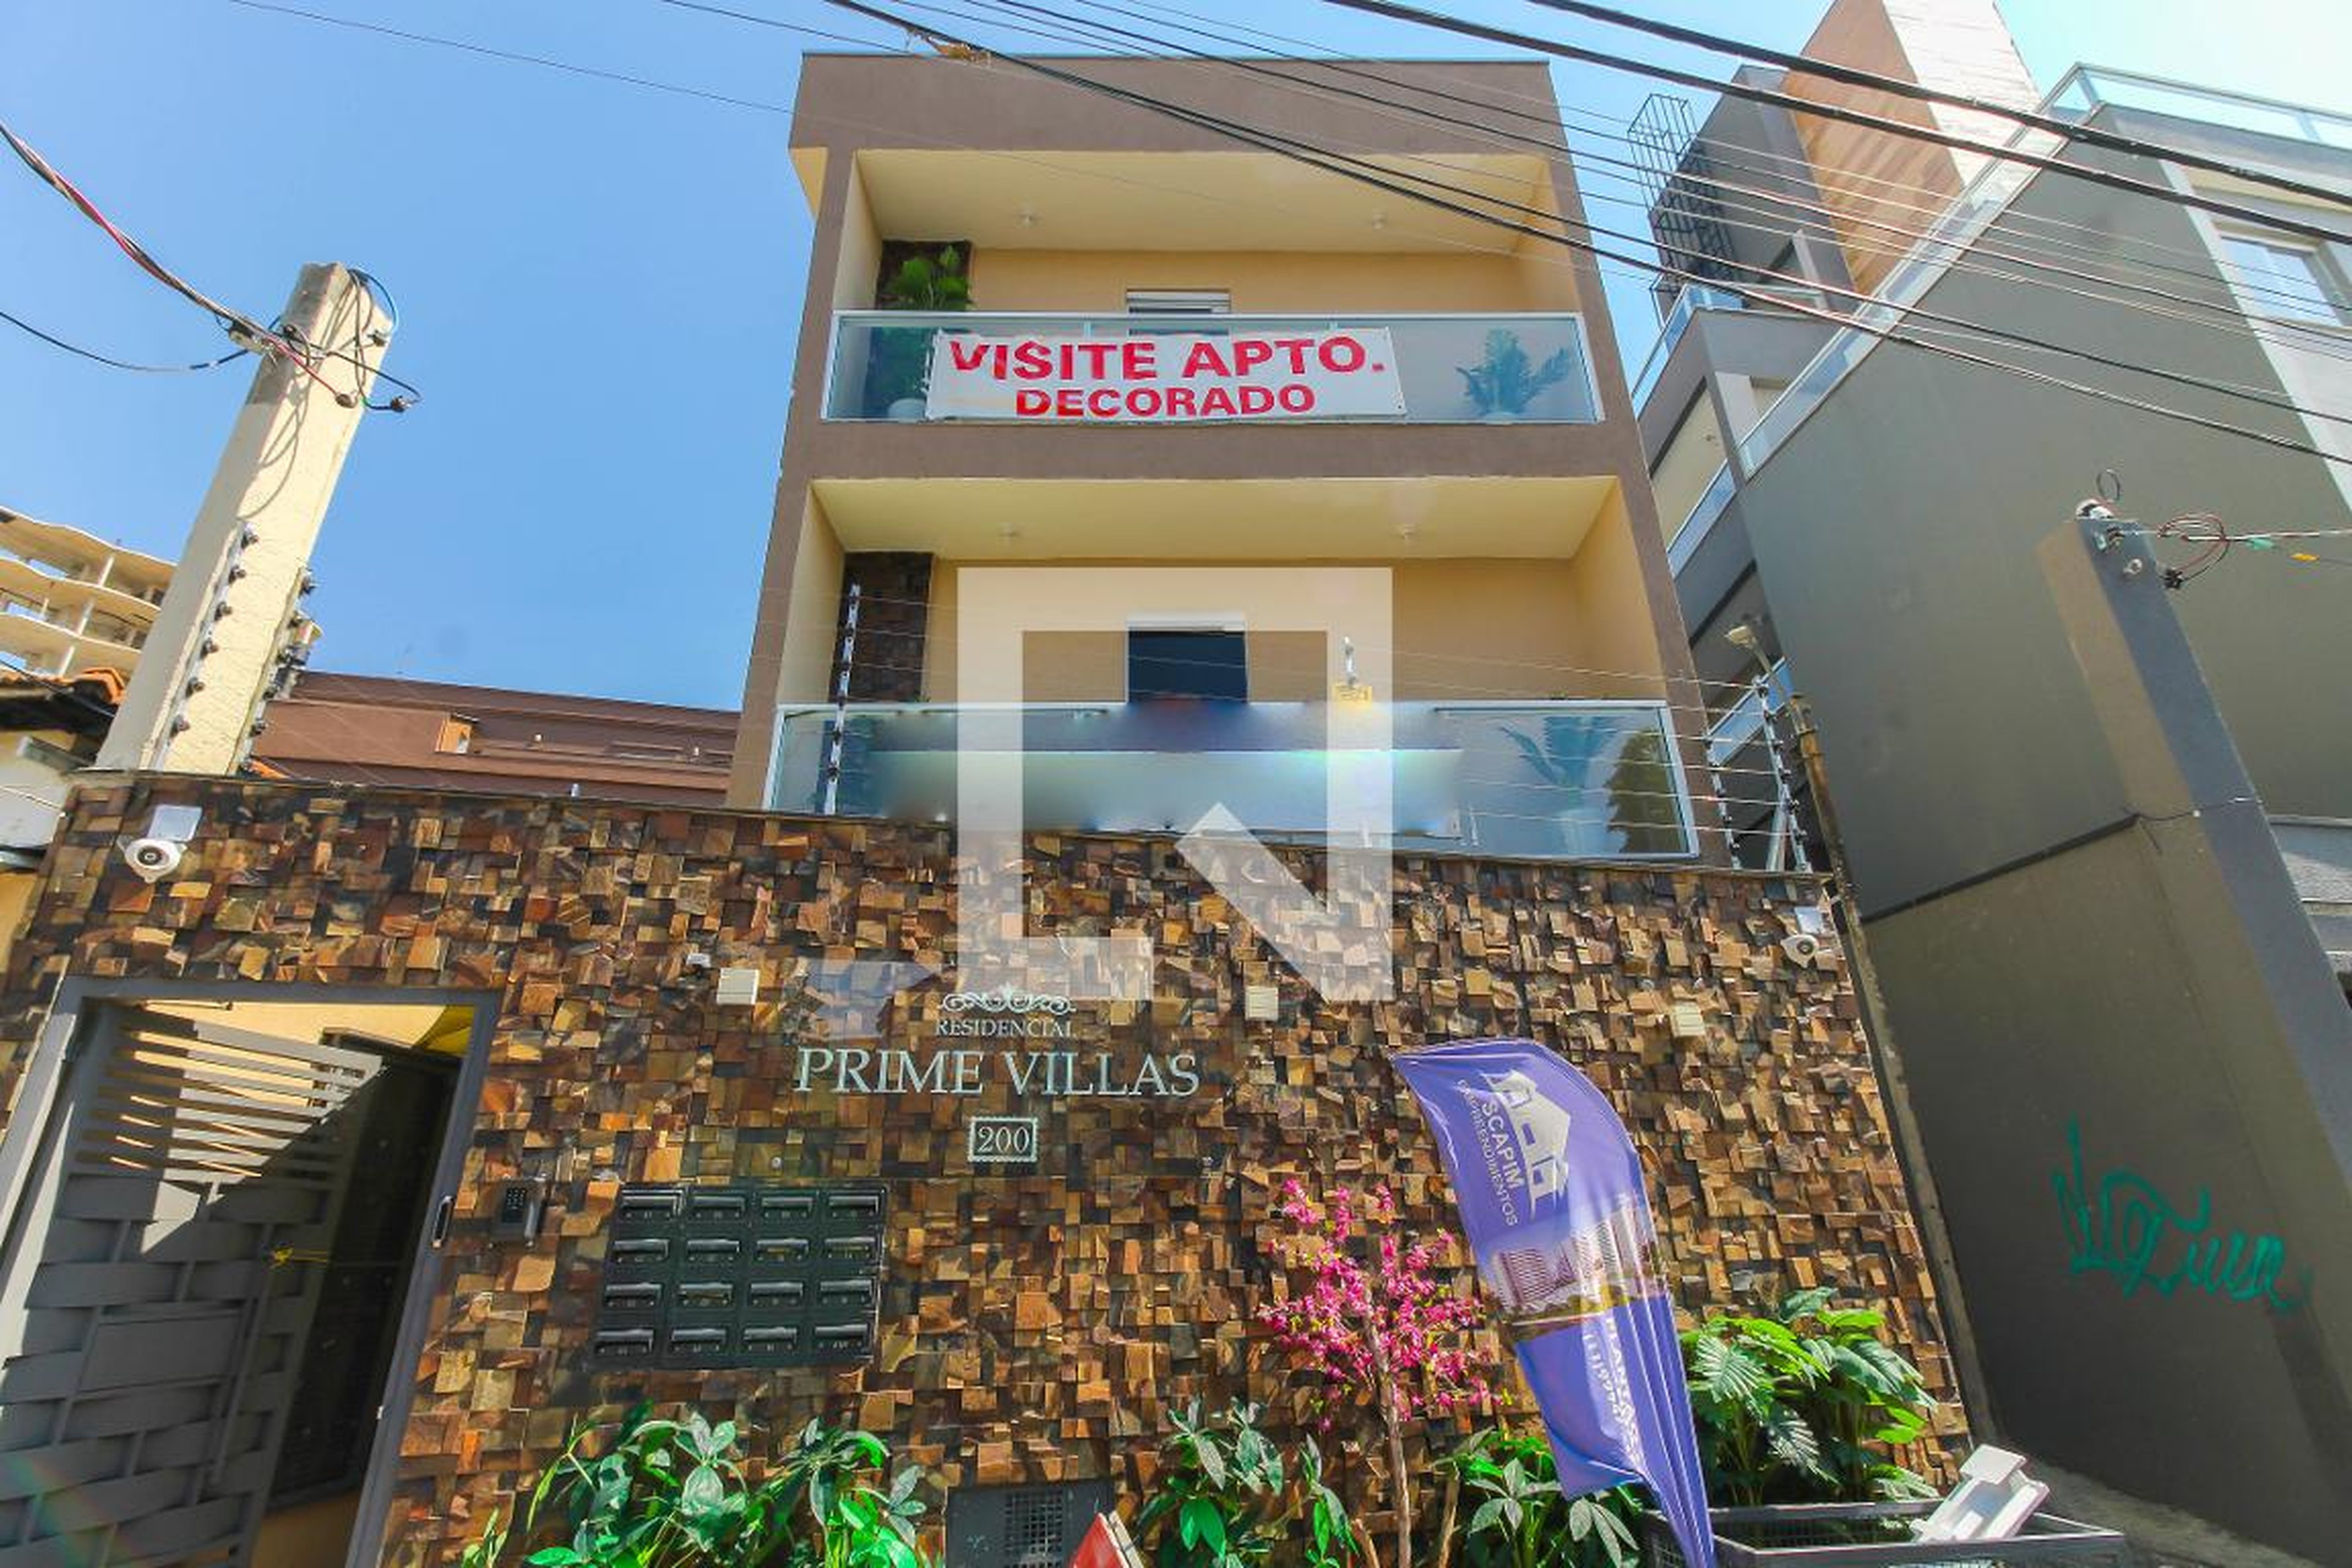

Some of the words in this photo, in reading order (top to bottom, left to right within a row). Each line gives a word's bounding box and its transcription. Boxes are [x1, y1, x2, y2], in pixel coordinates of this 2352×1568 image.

[950, 341, 1158, 380] VISITE
[1183, 336, 1385, 379] APTO.
[1016, 383, 1315, 416] DECORADO
[935, 1018, 1076, 1038] RESIDENCIAL
[796, 1047, 984, 1094] PRIME
[1005, 1052, 1200, 1096] VILLAS
[978, 1126, 1031, 1155] 200
[1482, 1102, 1525, 1189] SCAPIM
